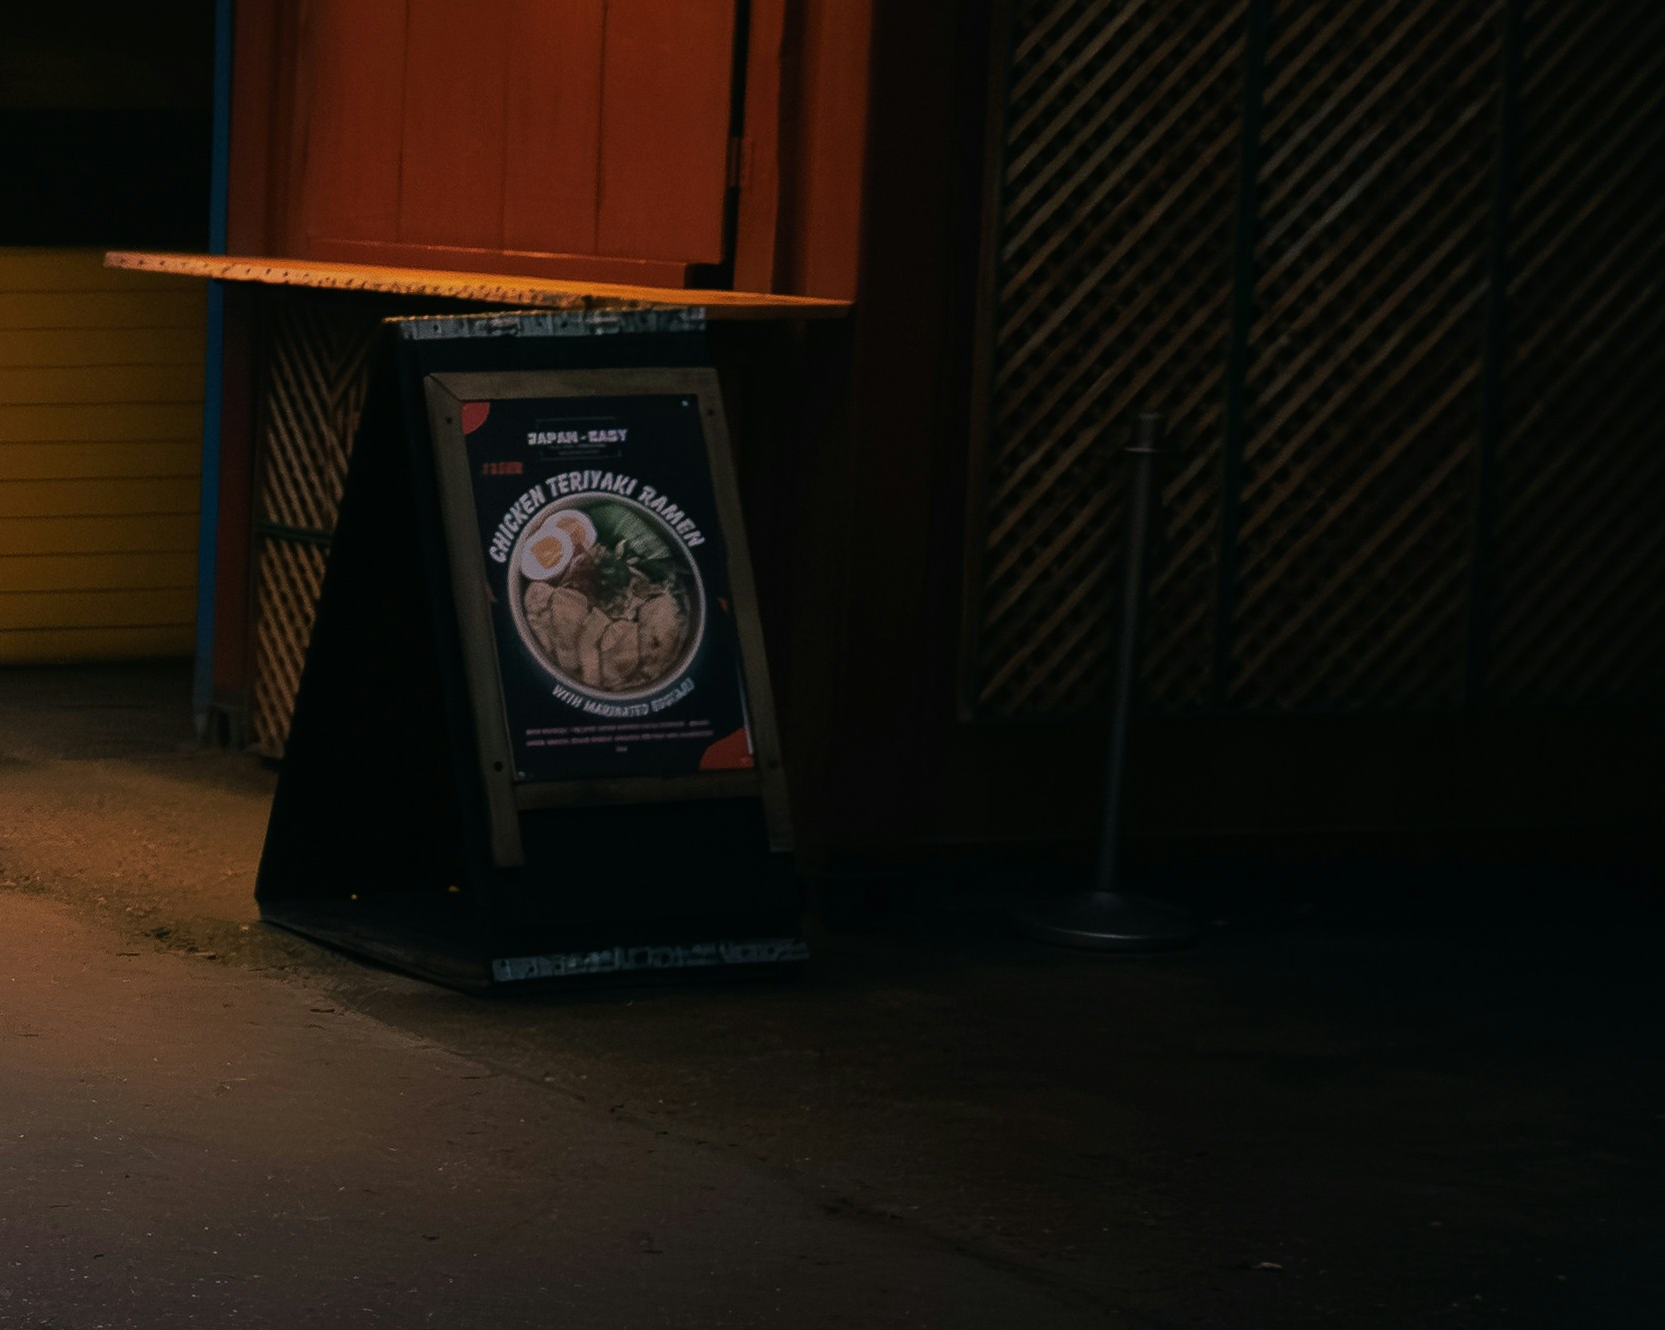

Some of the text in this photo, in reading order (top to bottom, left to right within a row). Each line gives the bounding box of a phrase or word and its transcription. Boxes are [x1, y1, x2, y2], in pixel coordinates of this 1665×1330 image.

[487, 469, 707, 564] CHICKEN TERIYAKI RAMEN
